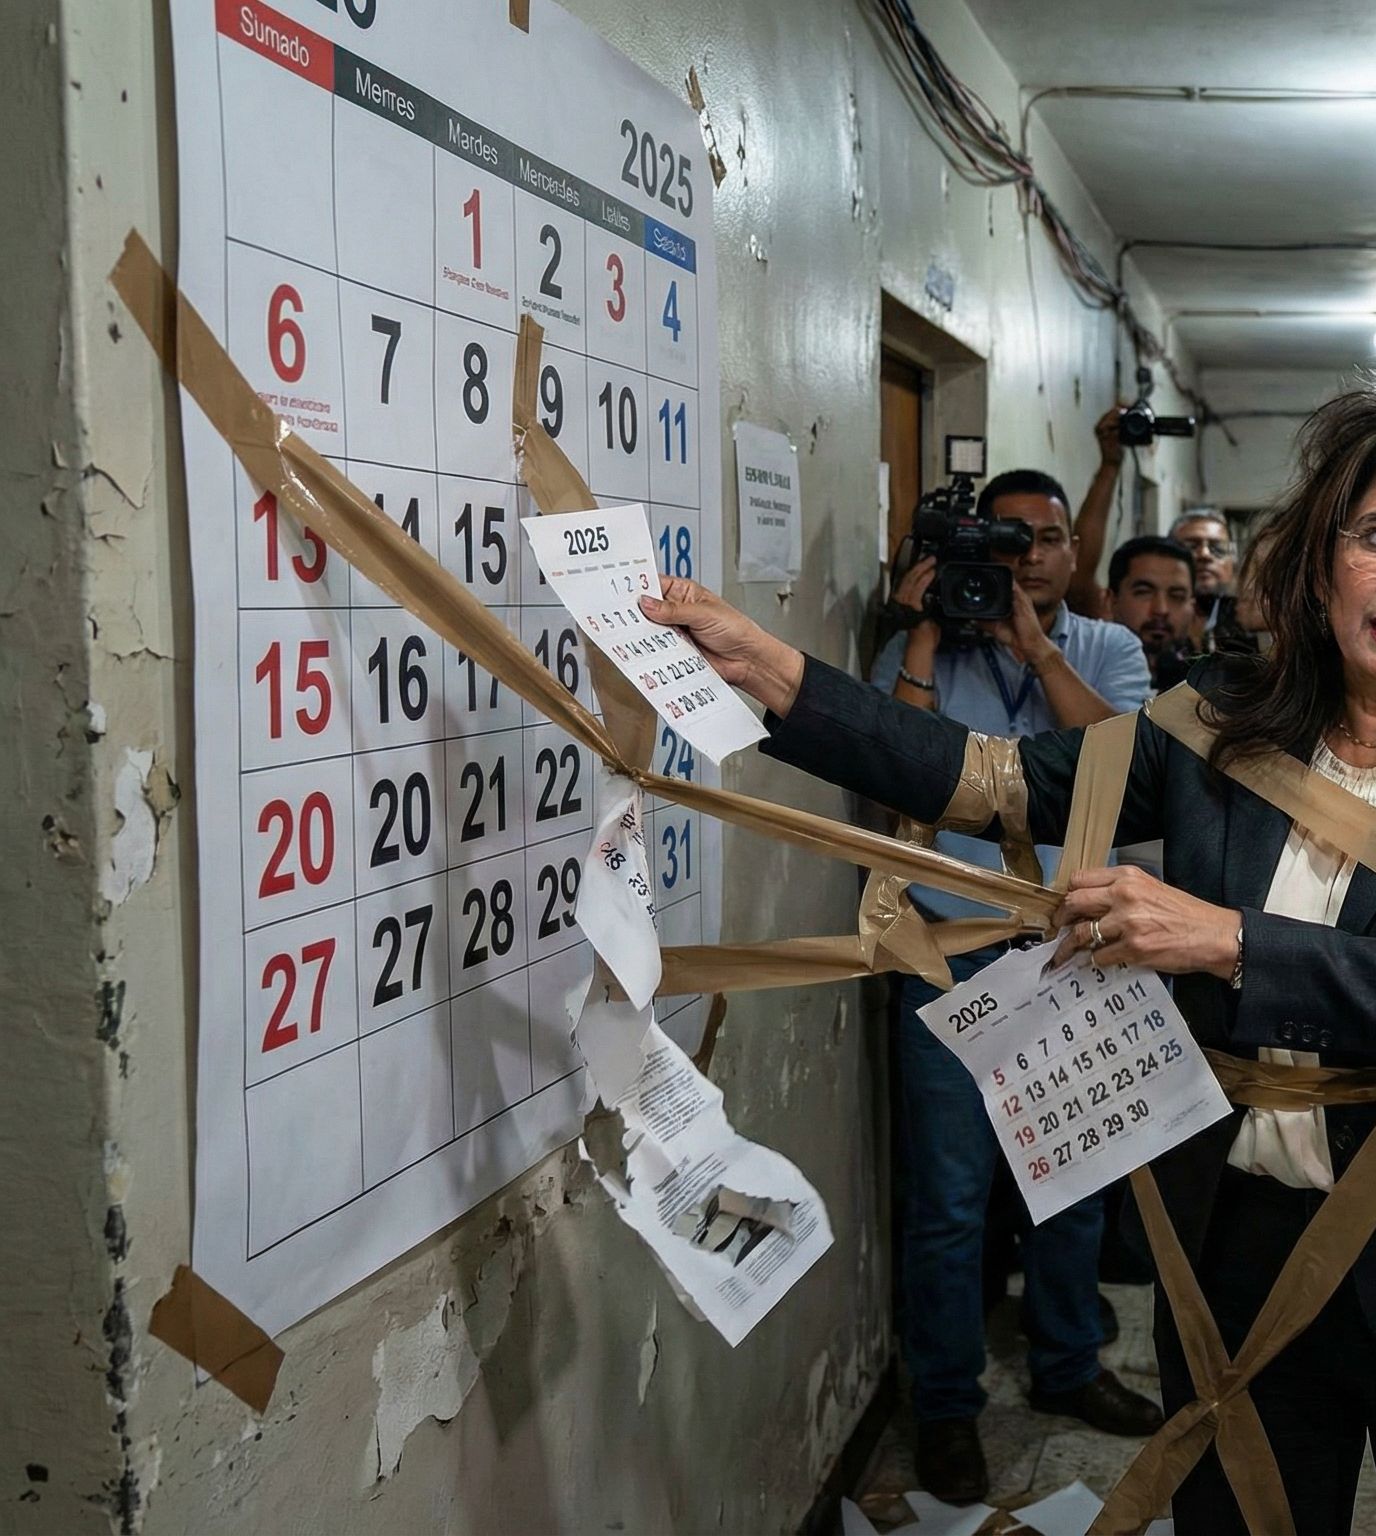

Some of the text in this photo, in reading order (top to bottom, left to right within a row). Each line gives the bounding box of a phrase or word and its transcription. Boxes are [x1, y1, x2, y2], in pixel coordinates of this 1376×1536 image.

[240, 6, 310, 67] Sumado
[448, 118, 498, 165] Mardes
[620, 119, 694, 218] 2025
[463, 189, 481, 269] 1
[540, 225, 563, 300] 2
[606, 253, 626, 323] 3
[662, 281, 681, 342] 4
[268, 284, 686, 464] 6 7 8 9 10 11
[455, 503, 507, 585] 15
[564, 526, 609, 556] 2025
[639, 573, 649, 590] 3
[256, 640, 331, 739] 15
[368, 635, 428, 723] 16
[258, 792, 335, 899] 20
[369, 772, 431, 868] 20
[460, 756, 506, 843] 21
[535, 744, 582, 822] 22
[262, 938, 336, 1053] 27
[372, 905, 433, 1007] 27
[462, 880, 515, 970] 28
[537, 857, 581, 939] 29
[662, 819, 691, 889] 31
[948, 991, 998, 1034] 2025
[992, 979, 1148, 1086] 5 6 7 8 9 10 11
[1048, 993, 1061, 1012] 1
[1070, 979, 1085, 999] 2
[1001, 1009, 1166, 1118] 12 13 14 15 16 17 18
[1013, 1038, 1184, 1149] 19 20 21 22 23 24 25
[1027, 1156, 1052, 1182] 26
[1052, 1141, 1074, 1167] 27
[1077, 1127, 1101, 1153] 28
[1102, 1112, 1126, 1138] 29
[1126, 1098, 1150, 1124] 30
